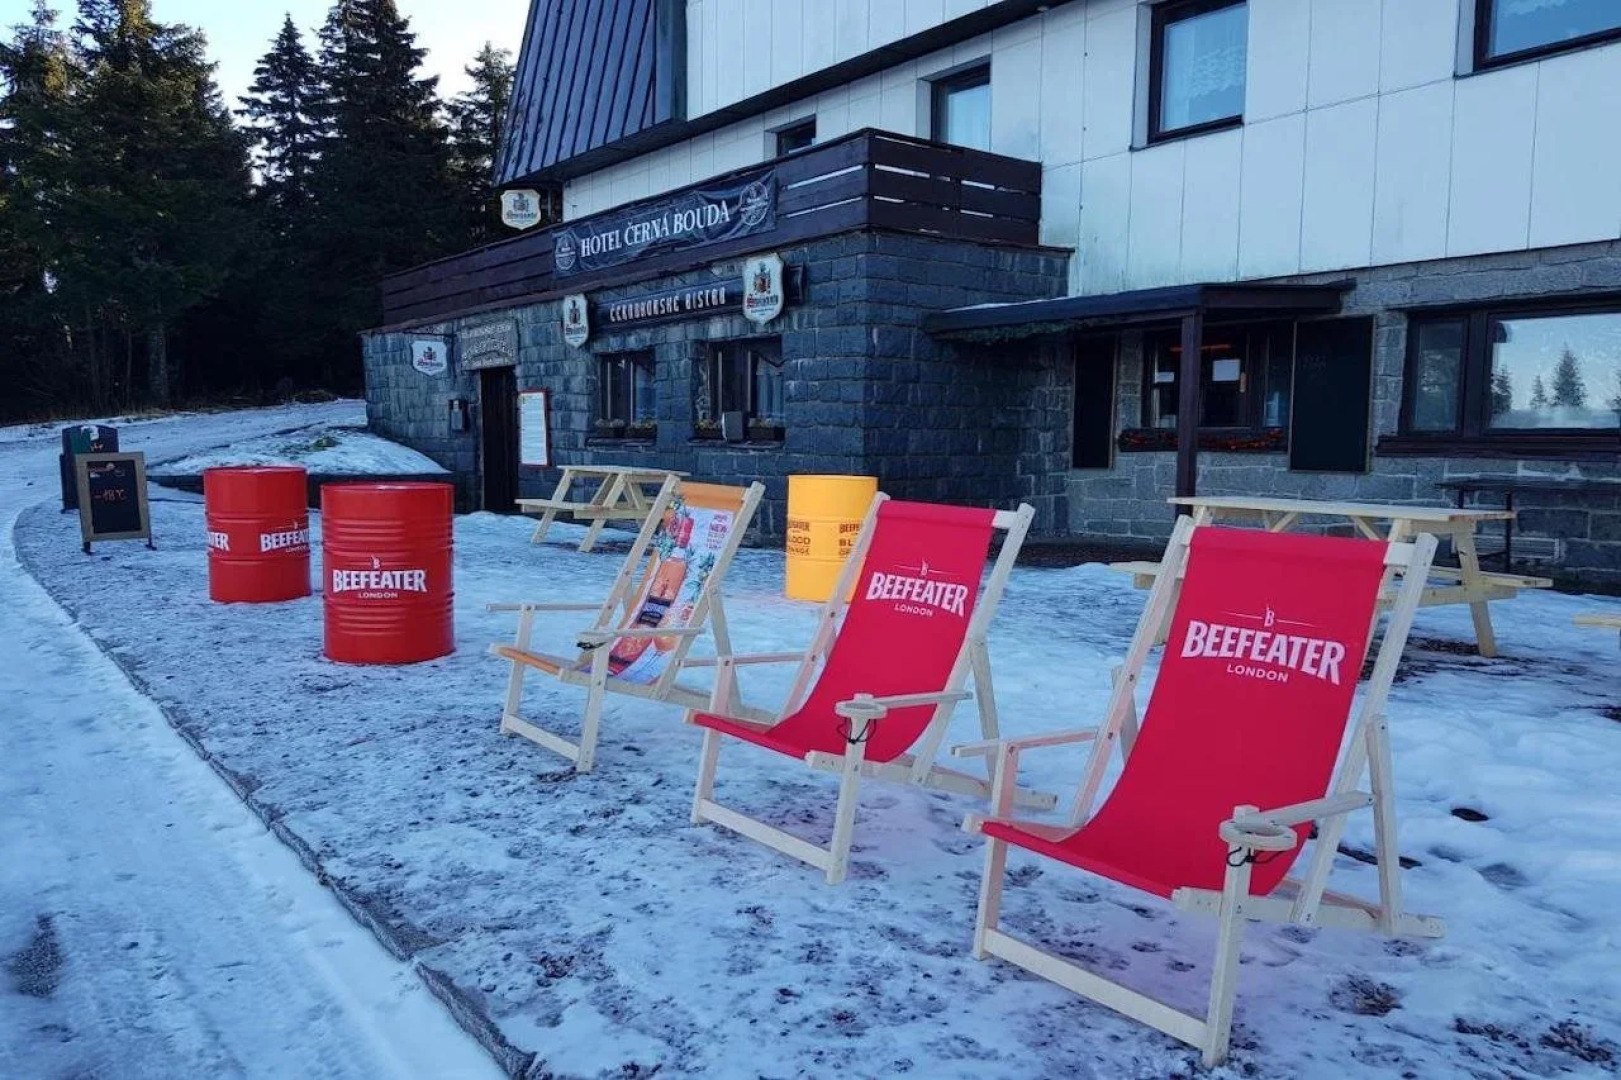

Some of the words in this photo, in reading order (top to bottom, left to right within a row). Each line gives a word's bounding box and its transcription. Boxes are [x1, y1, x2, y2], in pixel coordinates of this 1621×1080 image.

[580, 230, 622, 258] HOTEL
[624, 213, 670, 246] ČERNÁ
[673, 200, 730, 235] BOUDA
[333, 569, 427, 593] BEEFEATER
[865, 571, 969, 618] BEEFEATER
[894, 603, 933, 617] LONDON
[1180, 620, 1346, 685] BEEFEATER
[1226, 663, 1289, 683] LONDON
